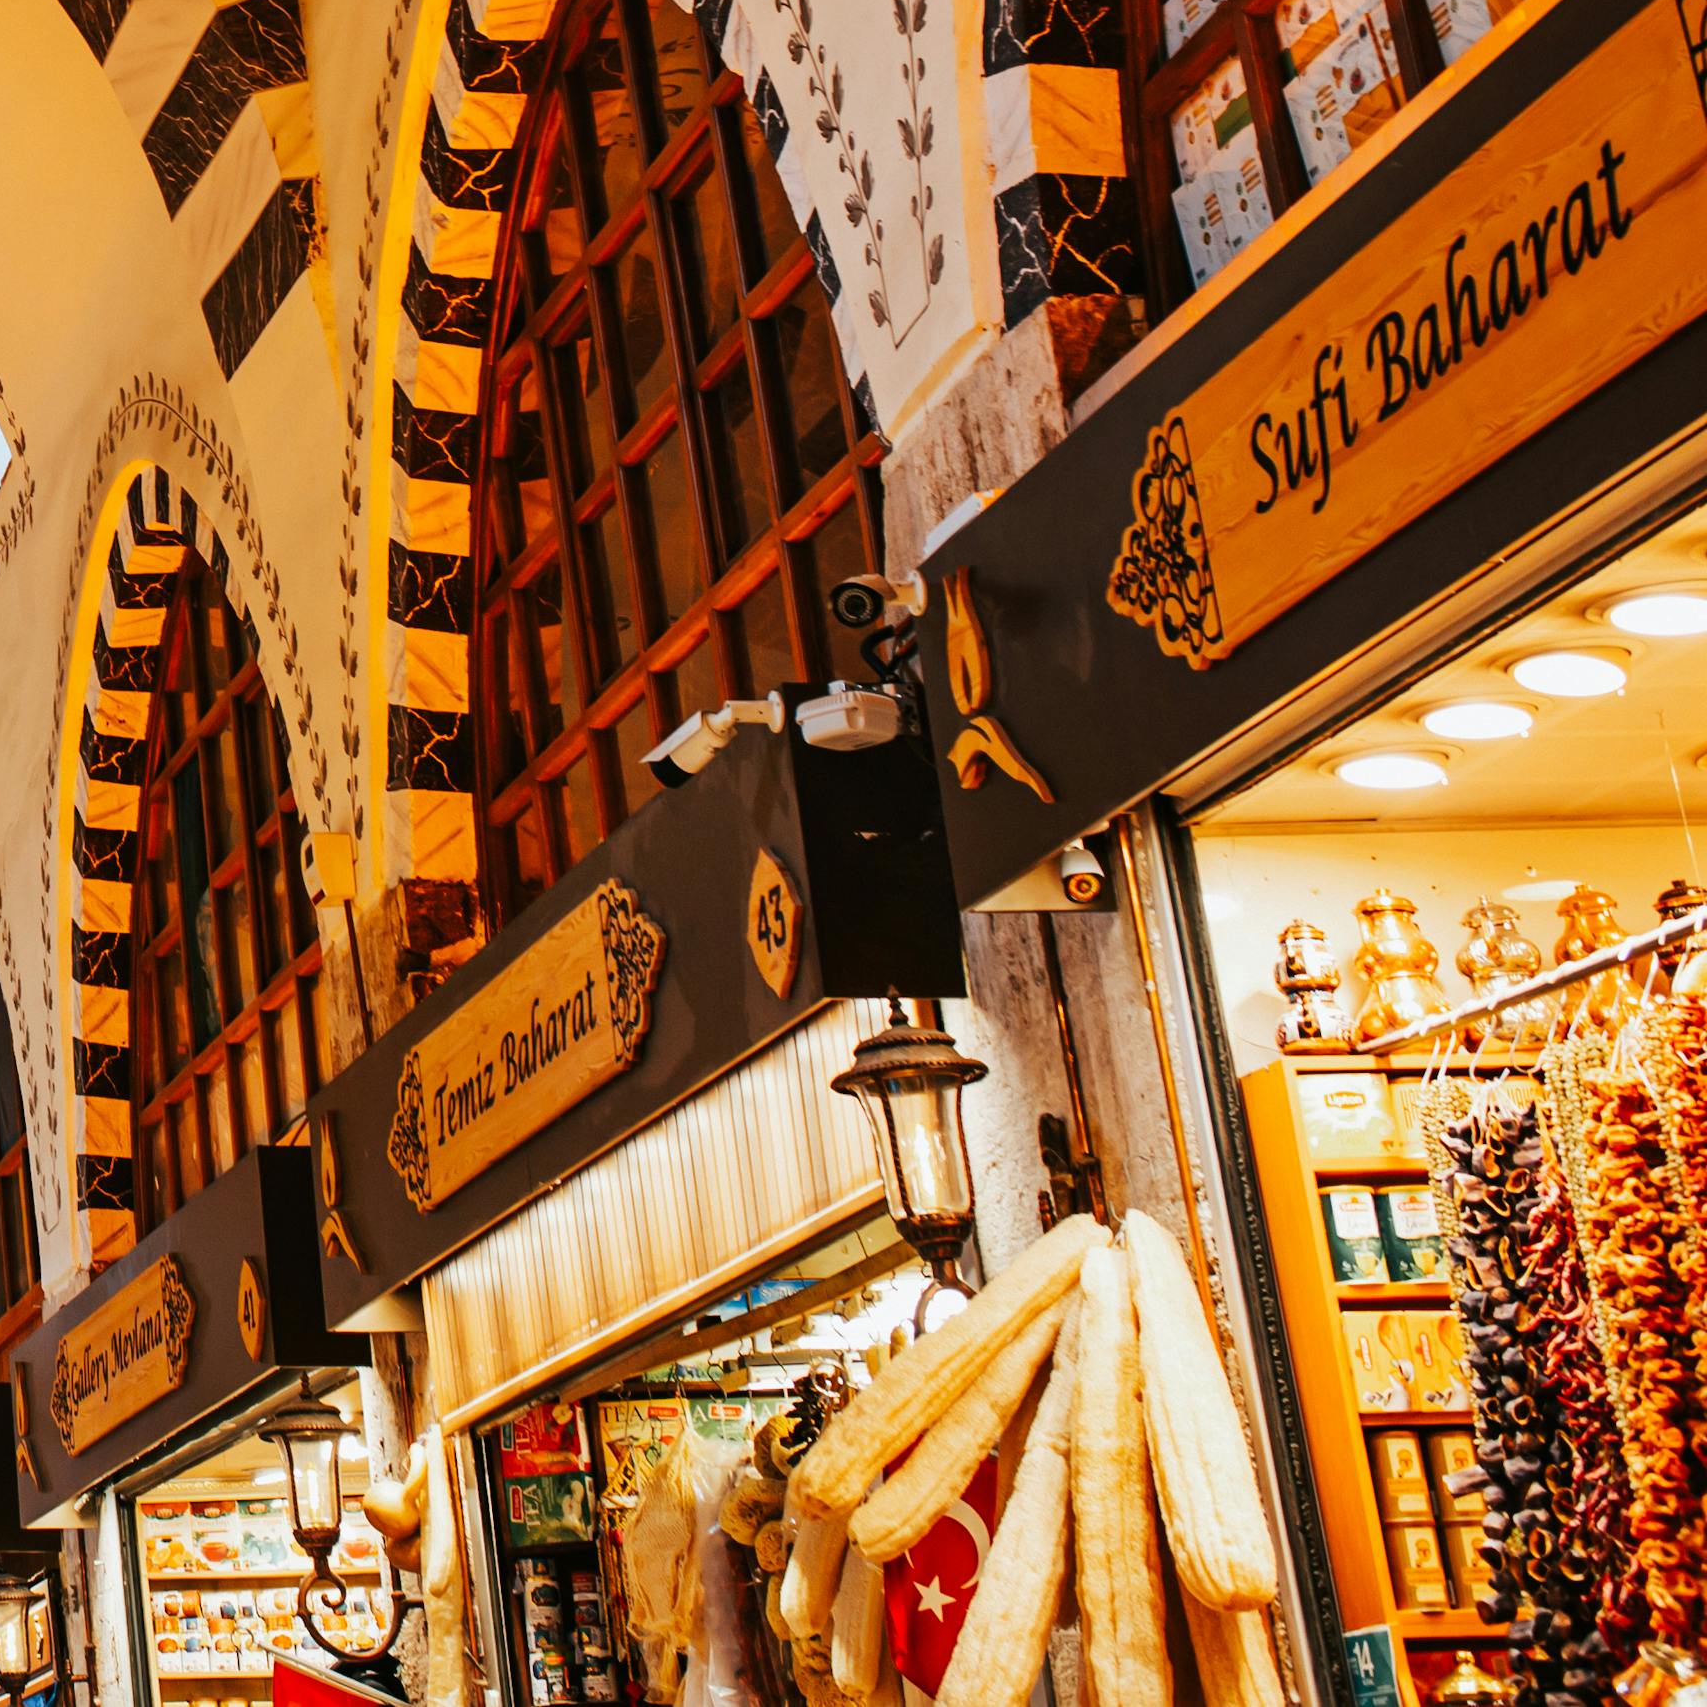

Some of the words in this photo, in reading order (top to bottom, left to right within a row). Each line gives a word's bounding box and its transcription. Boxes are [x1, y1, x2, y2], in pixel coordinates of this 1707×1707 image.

[1249, 343, 1359, 514] Sufi
[1365, 139, 1633, 423] Baharat
[758, 885, 787, 954] 43
[433, 1049, 495, 1145] Temiz
[500, 971, 598, 1097] Baharat
[242, 1288, 257, 1330] 41
[71, 1344, 111, 1416] Gallery
[113, 1306, 163, 1379] Mevlana
[602, 1405, 644, 1423] TEA
[522, 1484, 541, 1531] TEA
